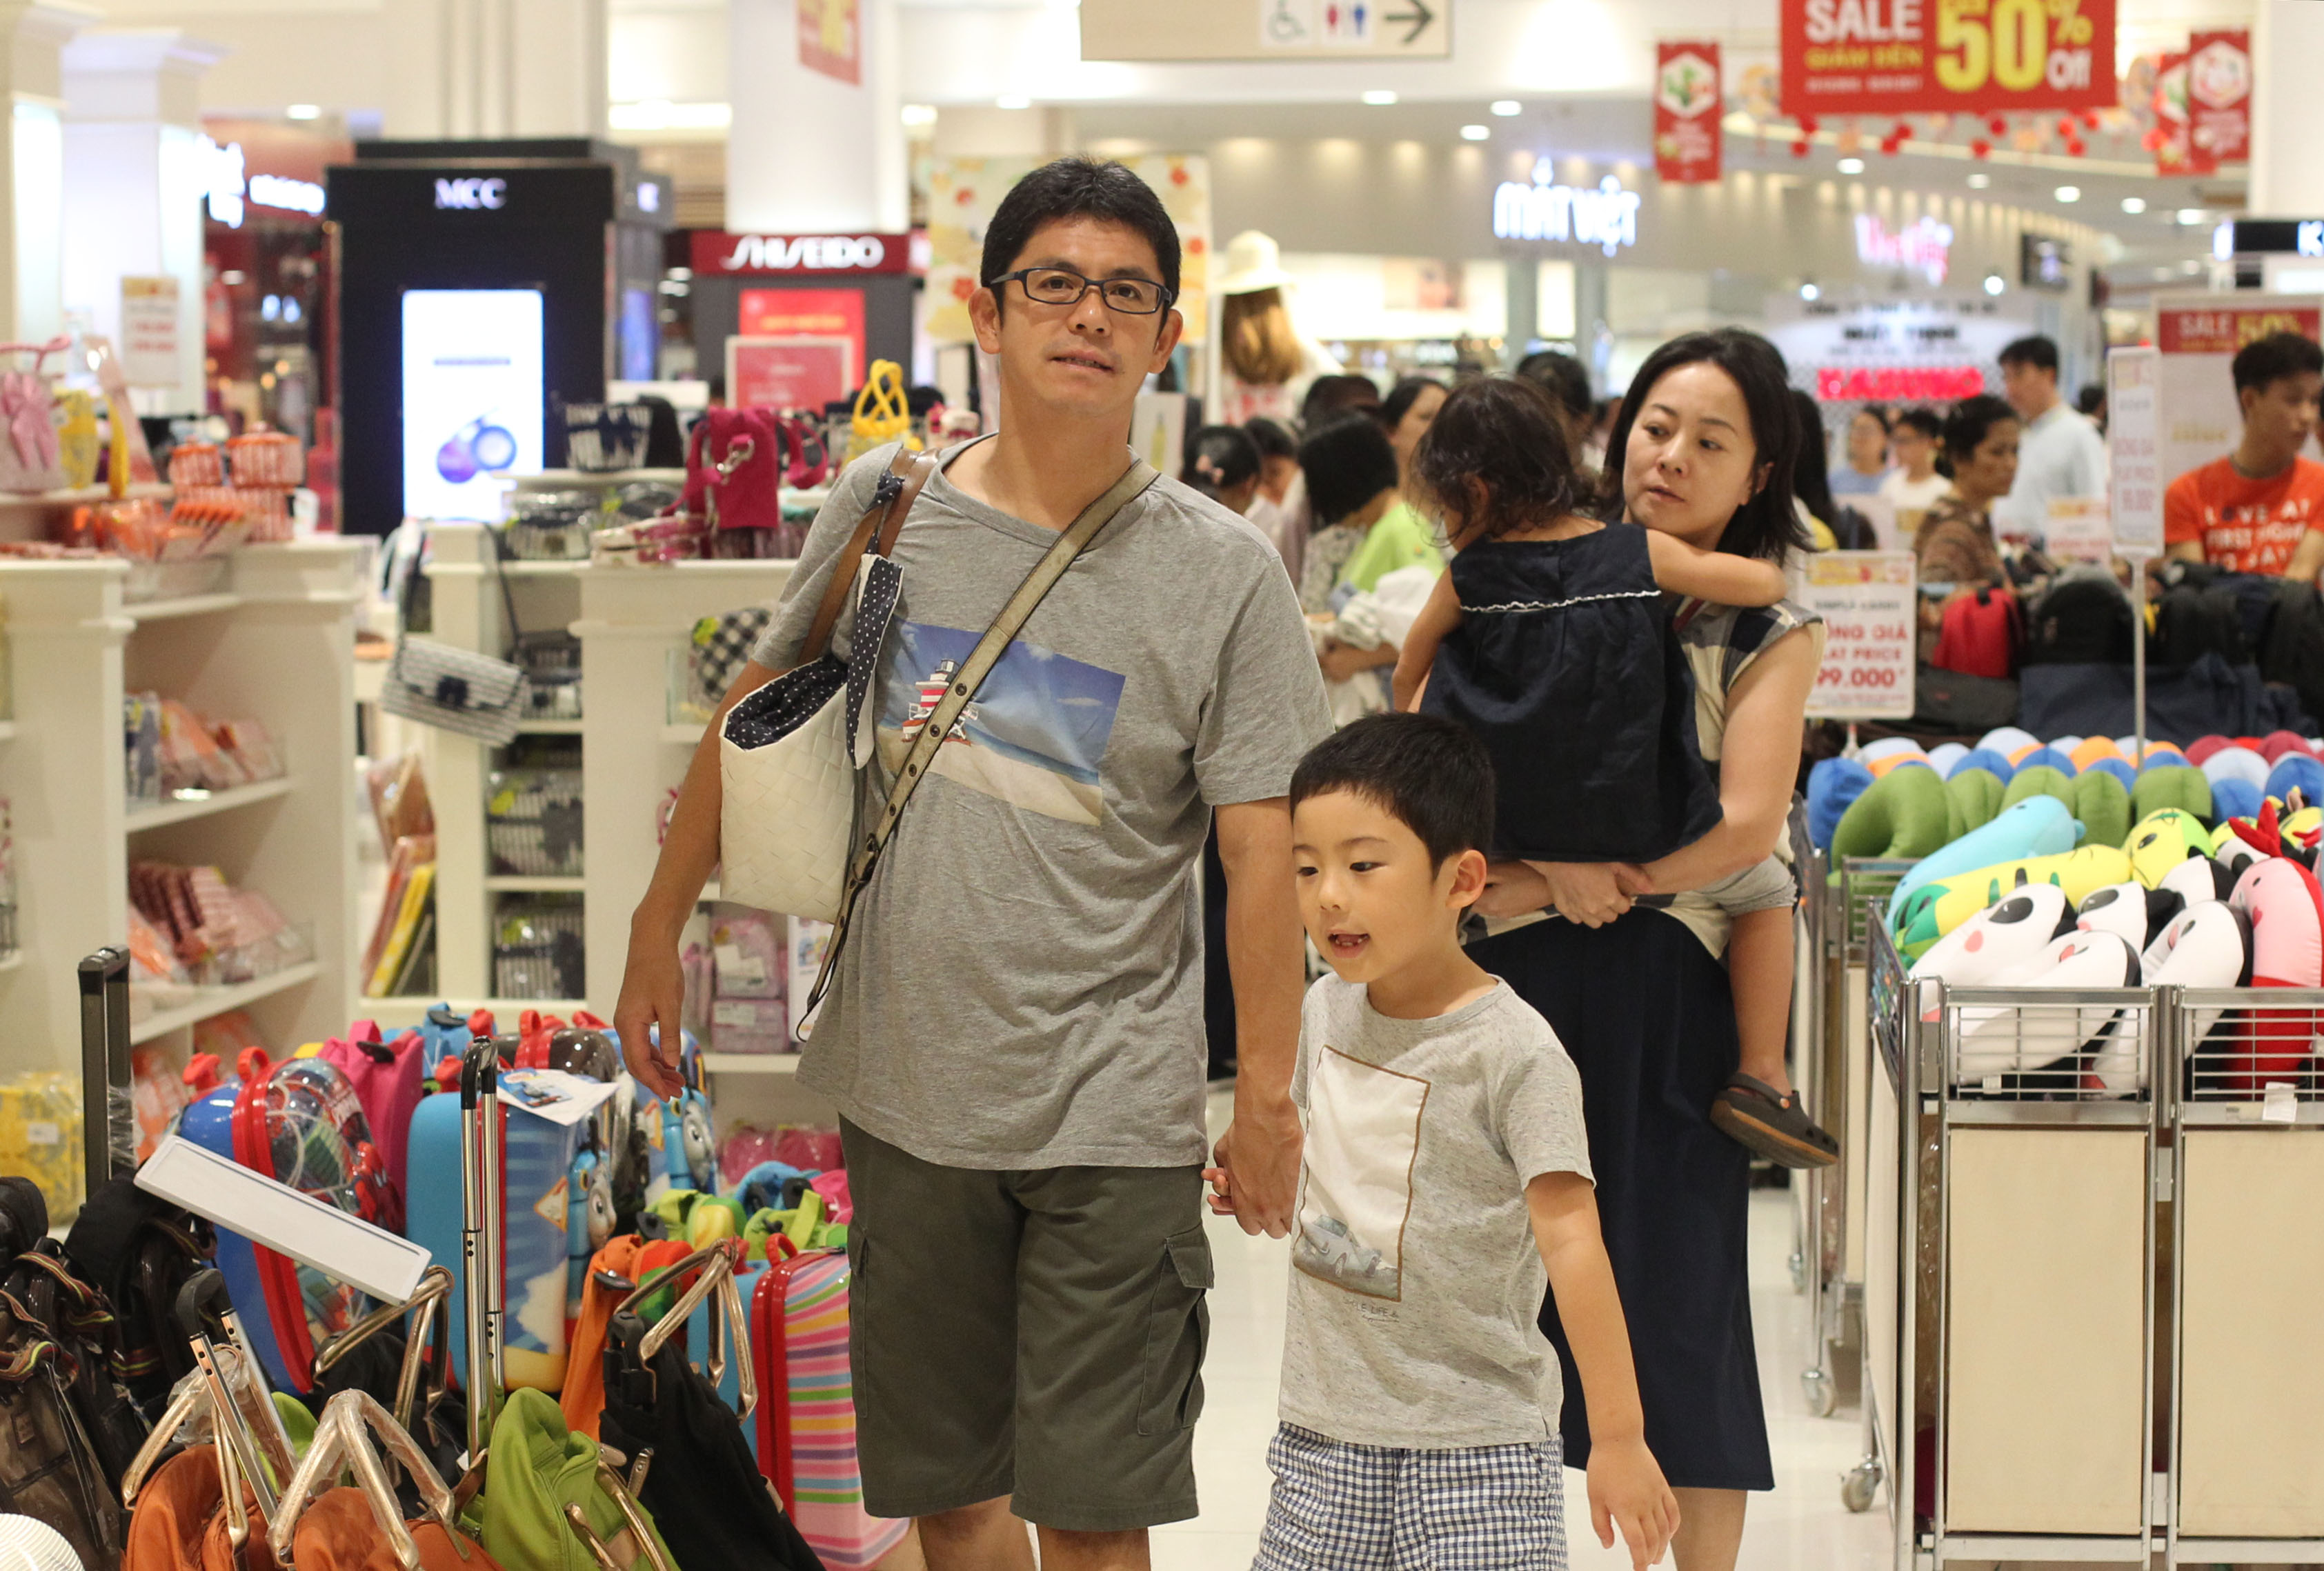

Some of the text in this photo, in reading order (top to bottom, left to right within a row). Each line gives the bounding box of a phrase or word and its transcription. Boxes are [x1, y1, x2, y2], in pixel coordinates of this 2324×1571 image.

[1805, 0, 1923, 42] SALE
[435, 177, 507, 210] MCC
[719, 234, 885, 270] SHISEIDO
[2178, 315, 2233, 337] SALE
